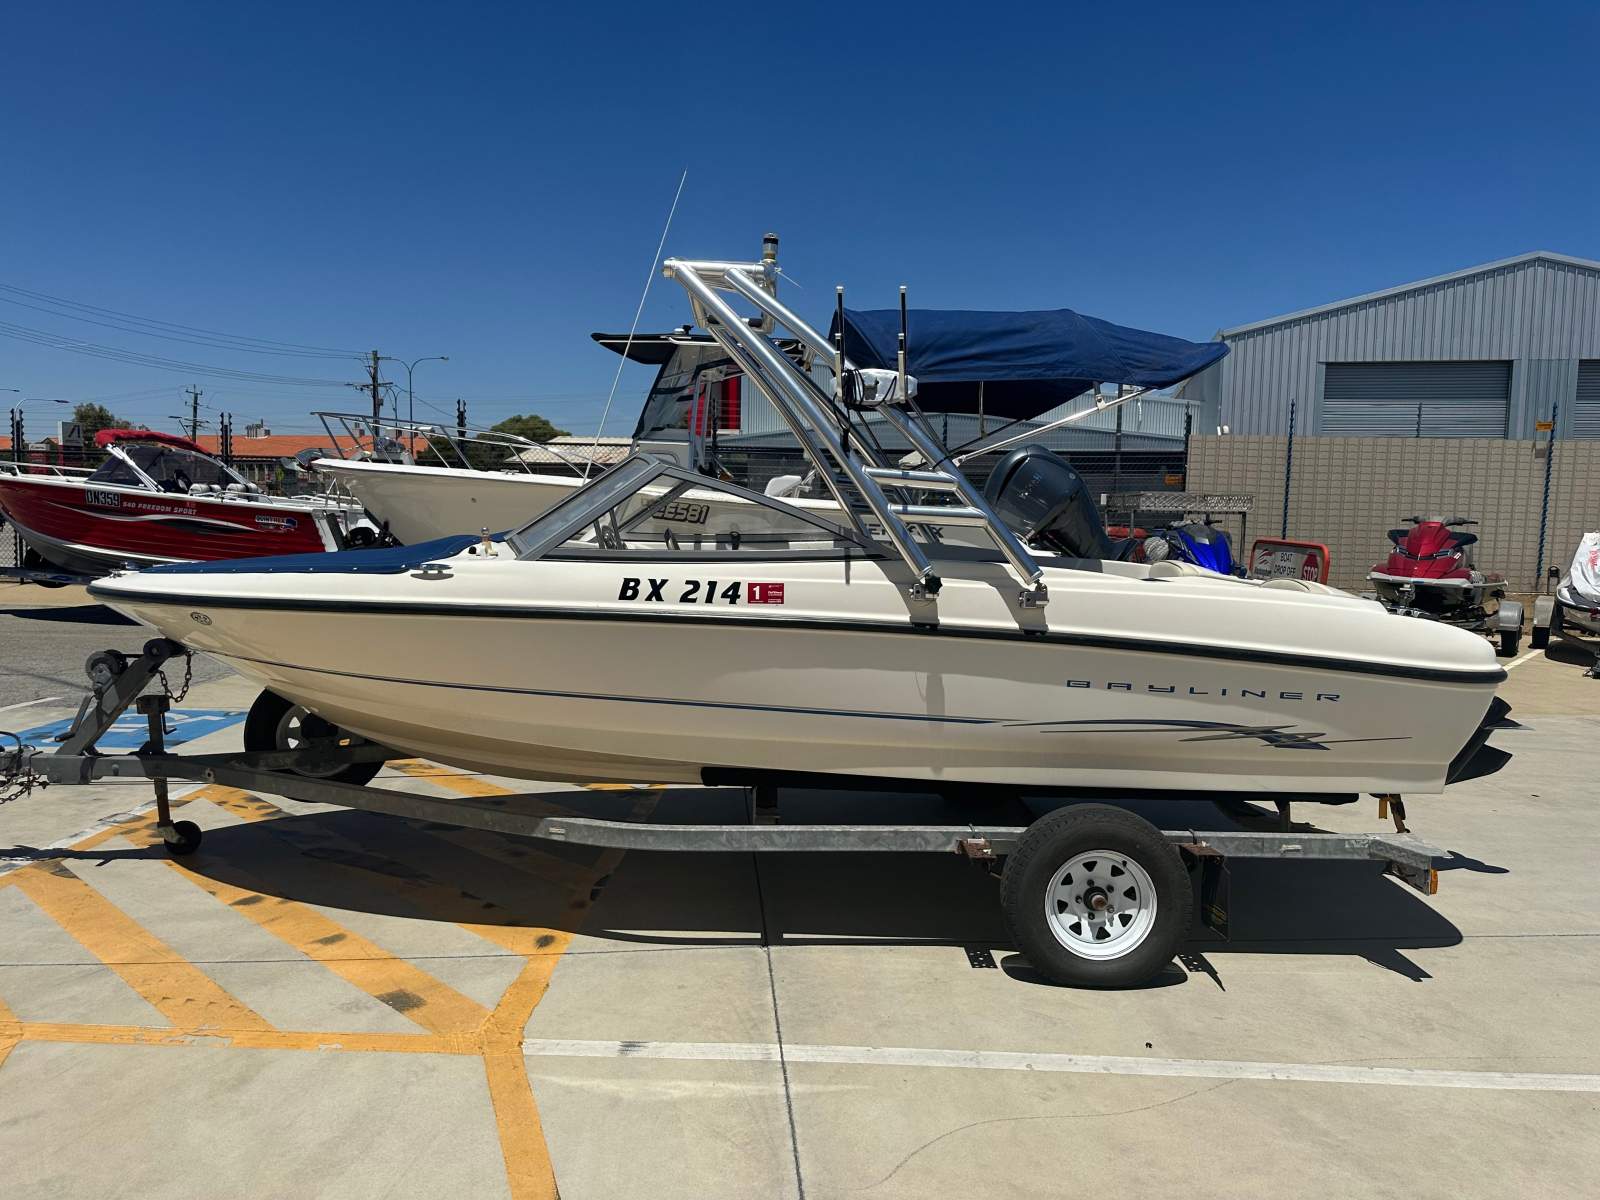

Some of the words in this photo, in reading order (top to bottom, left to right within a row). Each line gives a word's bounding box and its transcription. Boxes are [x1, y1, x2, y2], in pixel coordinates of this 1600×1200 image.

[137, 503, 171, 513] FREEDOM
[173, 507, 198, 516] SPORT
[1304, 566, 1318, 581] STOP
[618, 577, 669, 602] BX
[679, 580, 741, 605] 214
[752, 585, 760, 600] 1
[1066, 679, 1341, 702] BAYLINER
